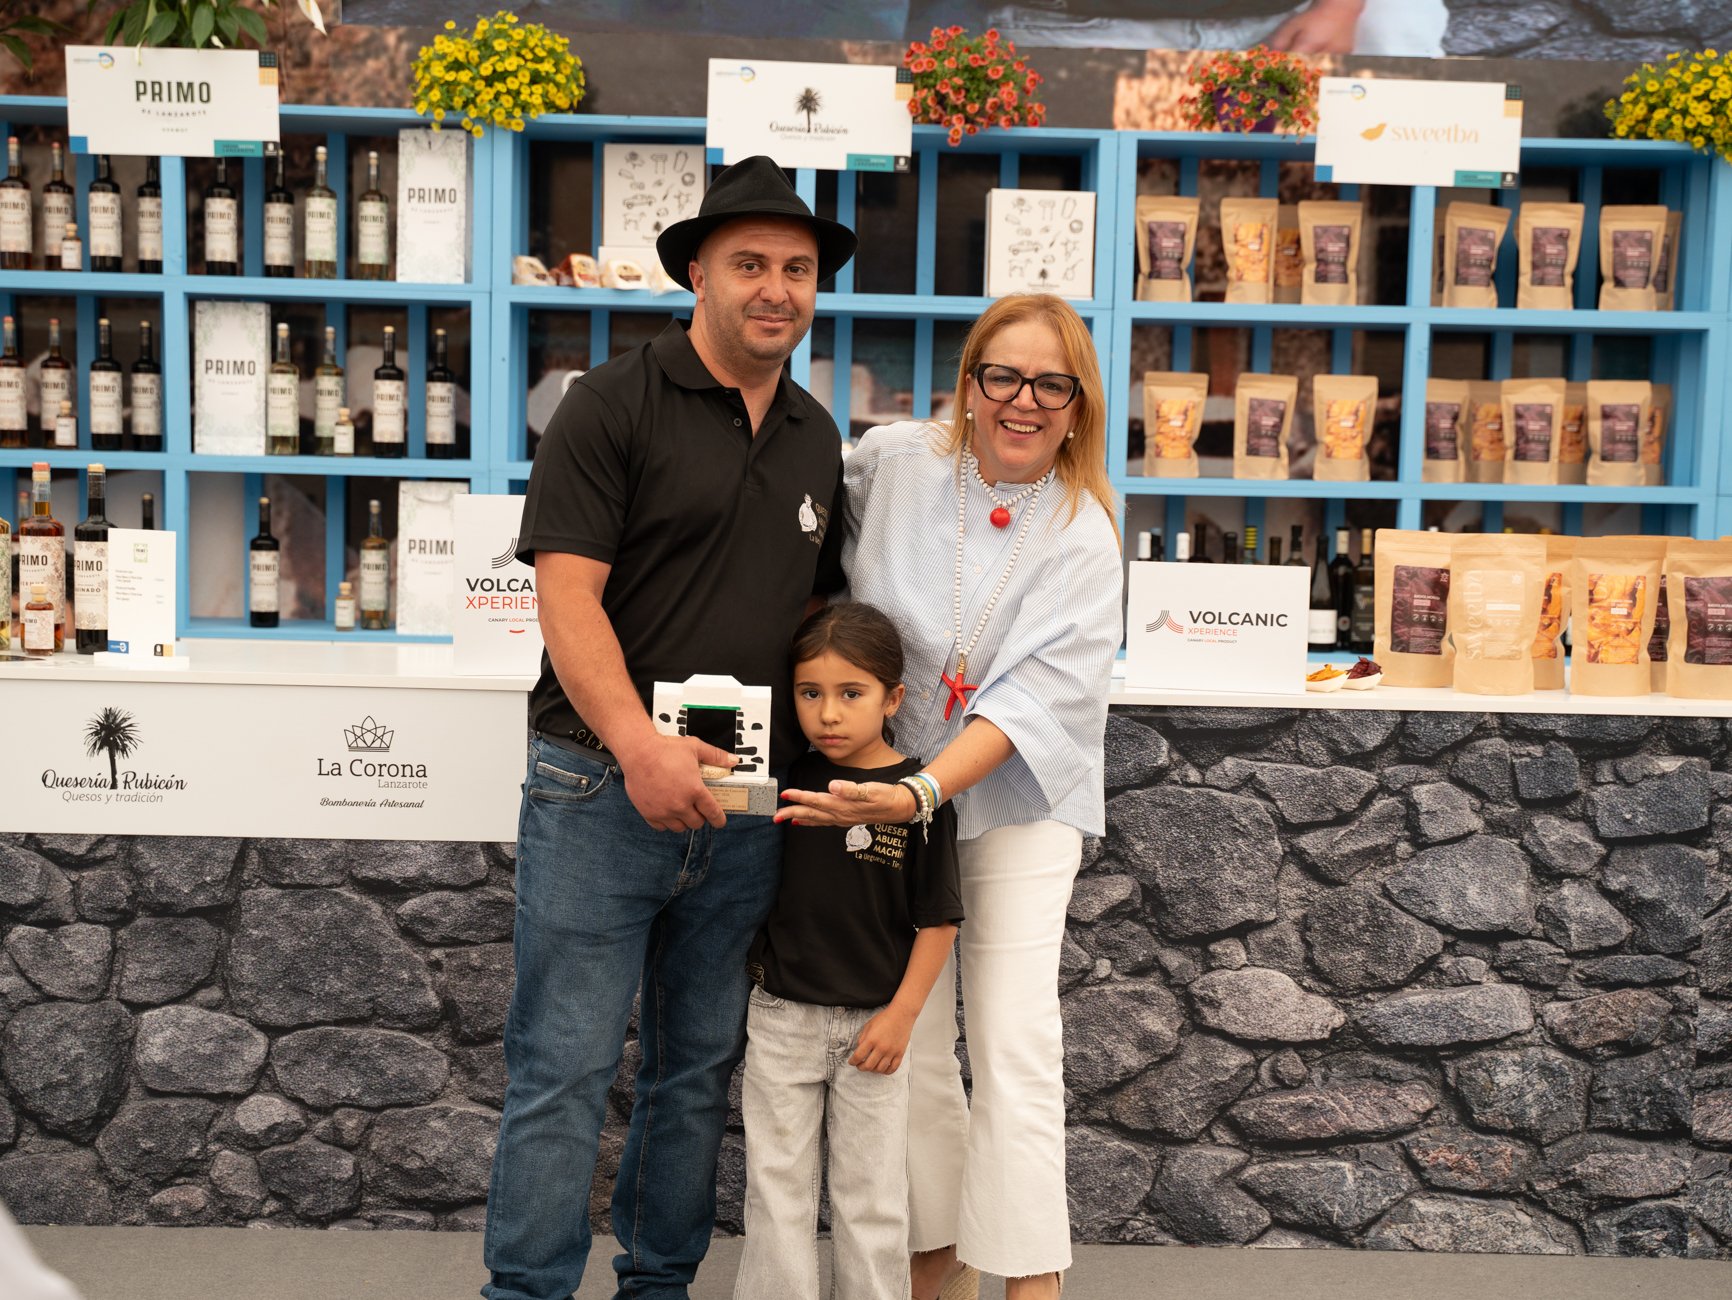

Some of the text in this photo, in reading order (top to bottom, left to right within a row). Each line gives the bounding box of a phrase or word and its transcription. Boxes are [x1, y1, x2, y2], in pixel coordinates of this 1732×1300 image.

[135, 80, 212, 104] PRIMO
[1391, 123, 1480, 144] sweetba
[407, 187, 458, 205] PRIMO
[204, 359, 257, 376] PRIMO
[465, 577, 534, 592] VOLCA
[1188, 610, 1289, 628] VOLCANIC
[1187, 627, 1238, 637] XPERIENCE
[317, 758, 428, 778] La Corona
[41, 768, 188, 790] Quesería Rubicón
[377, 779, 428, 789] Lanzarote
[62, 790, 163, 804] Quesos y tradición
[319, 797, 425, 809] Bombonería Artesanal
